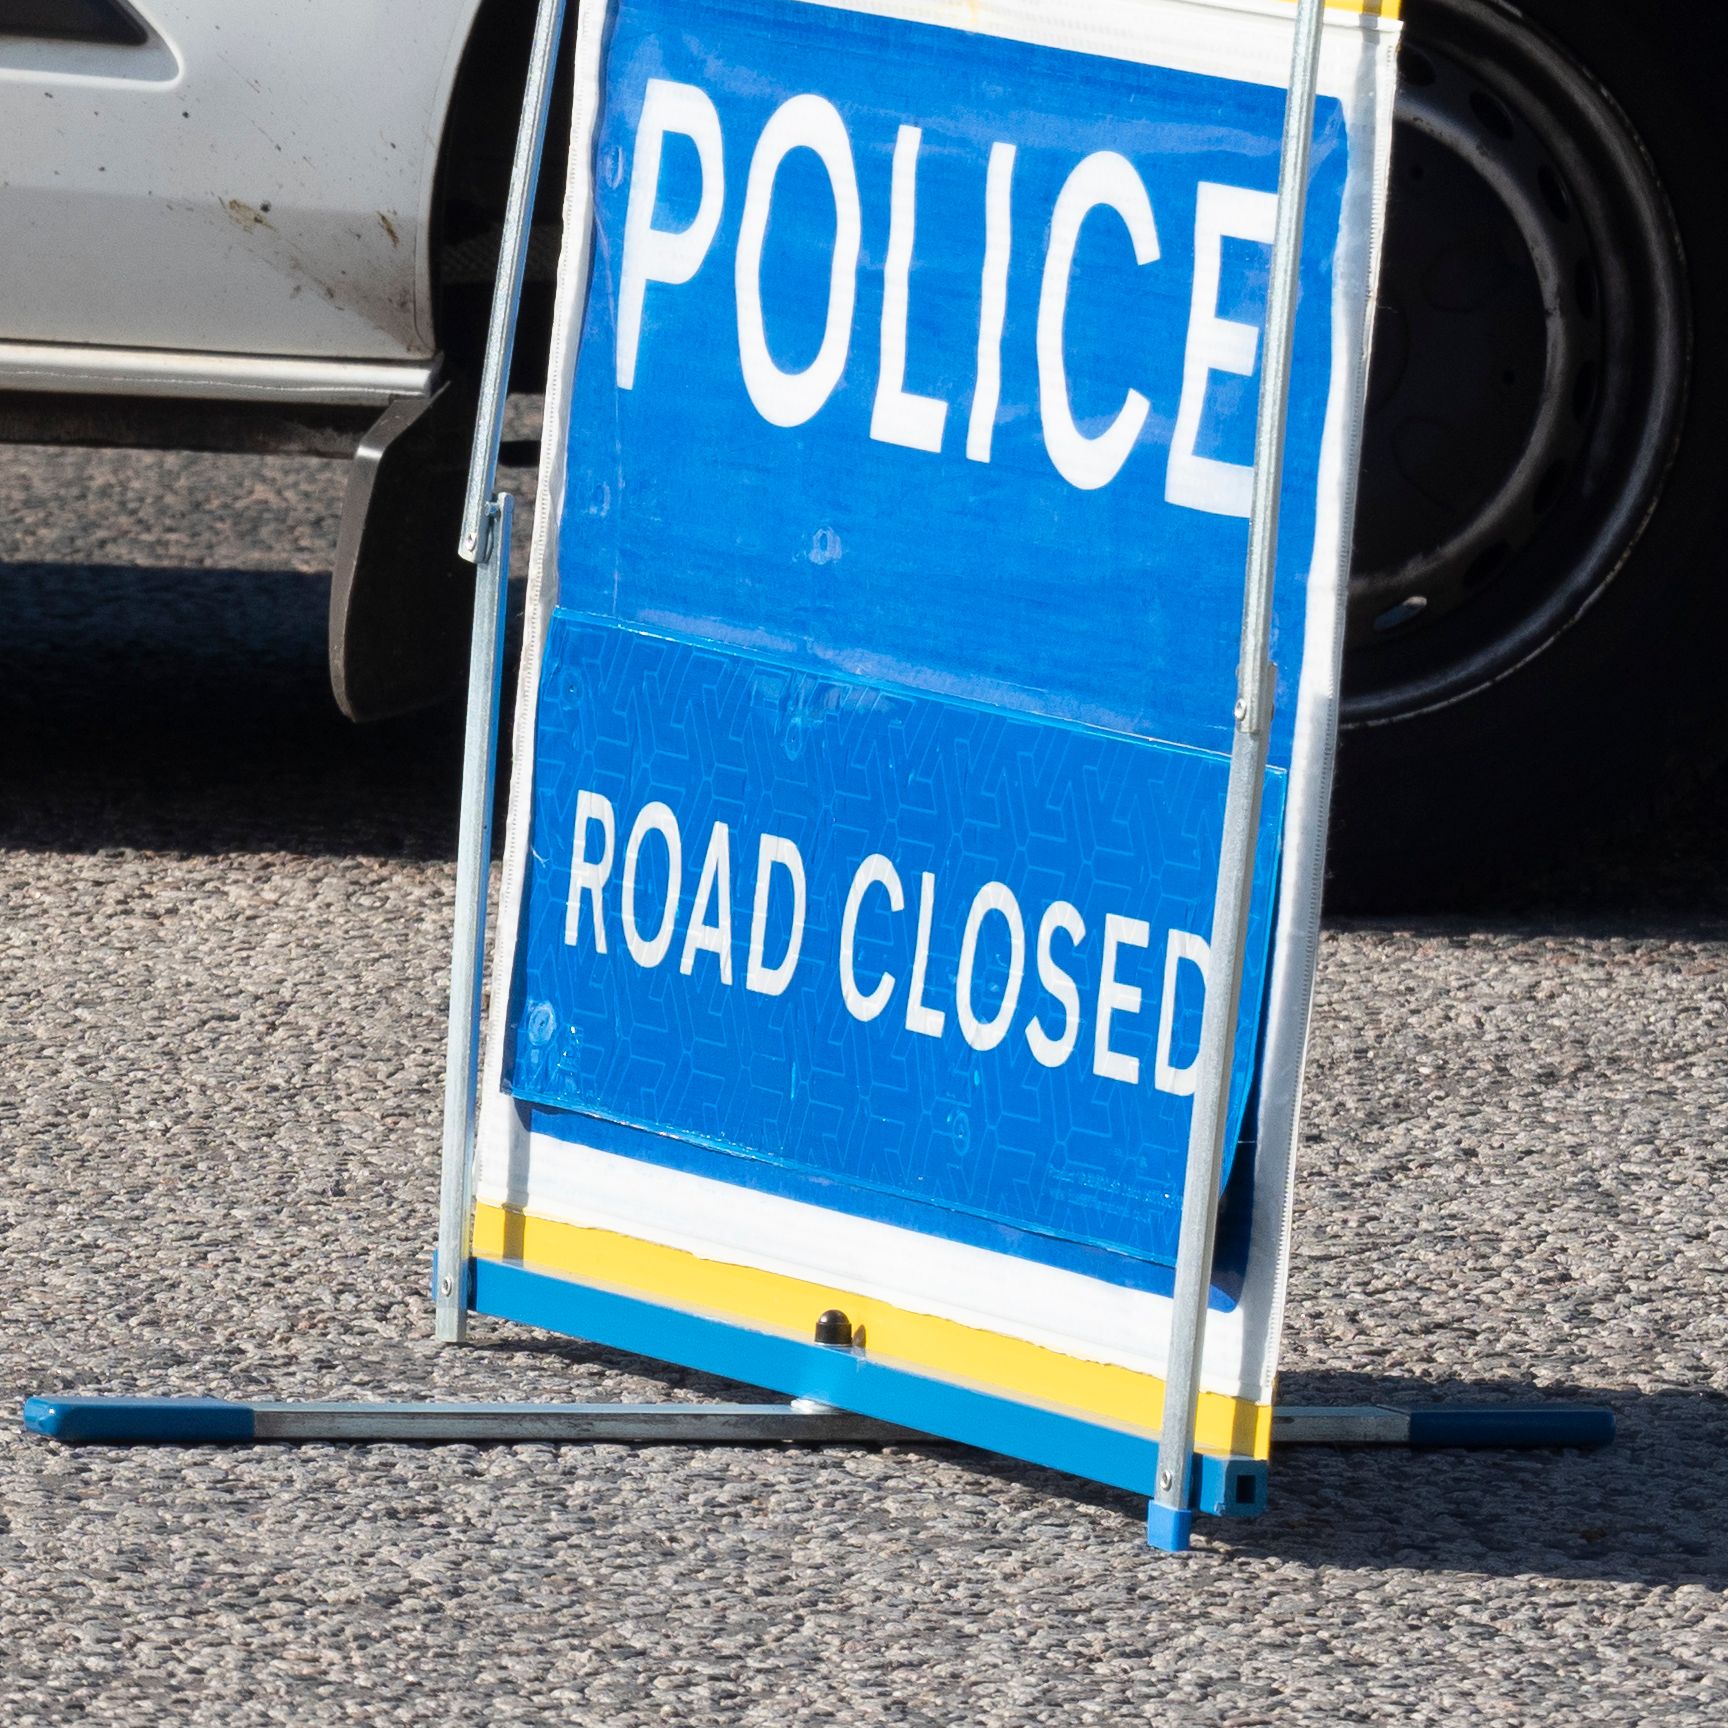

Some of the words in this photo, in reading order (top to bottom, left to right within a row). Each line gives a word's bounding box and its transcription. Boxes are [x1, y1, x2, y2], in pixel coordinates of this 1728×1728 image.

[615, 78, 1277, 519] POLICE
[563, 790, 808, 997] ROAD
[839, 850, 1214, 1098] CLOSED
